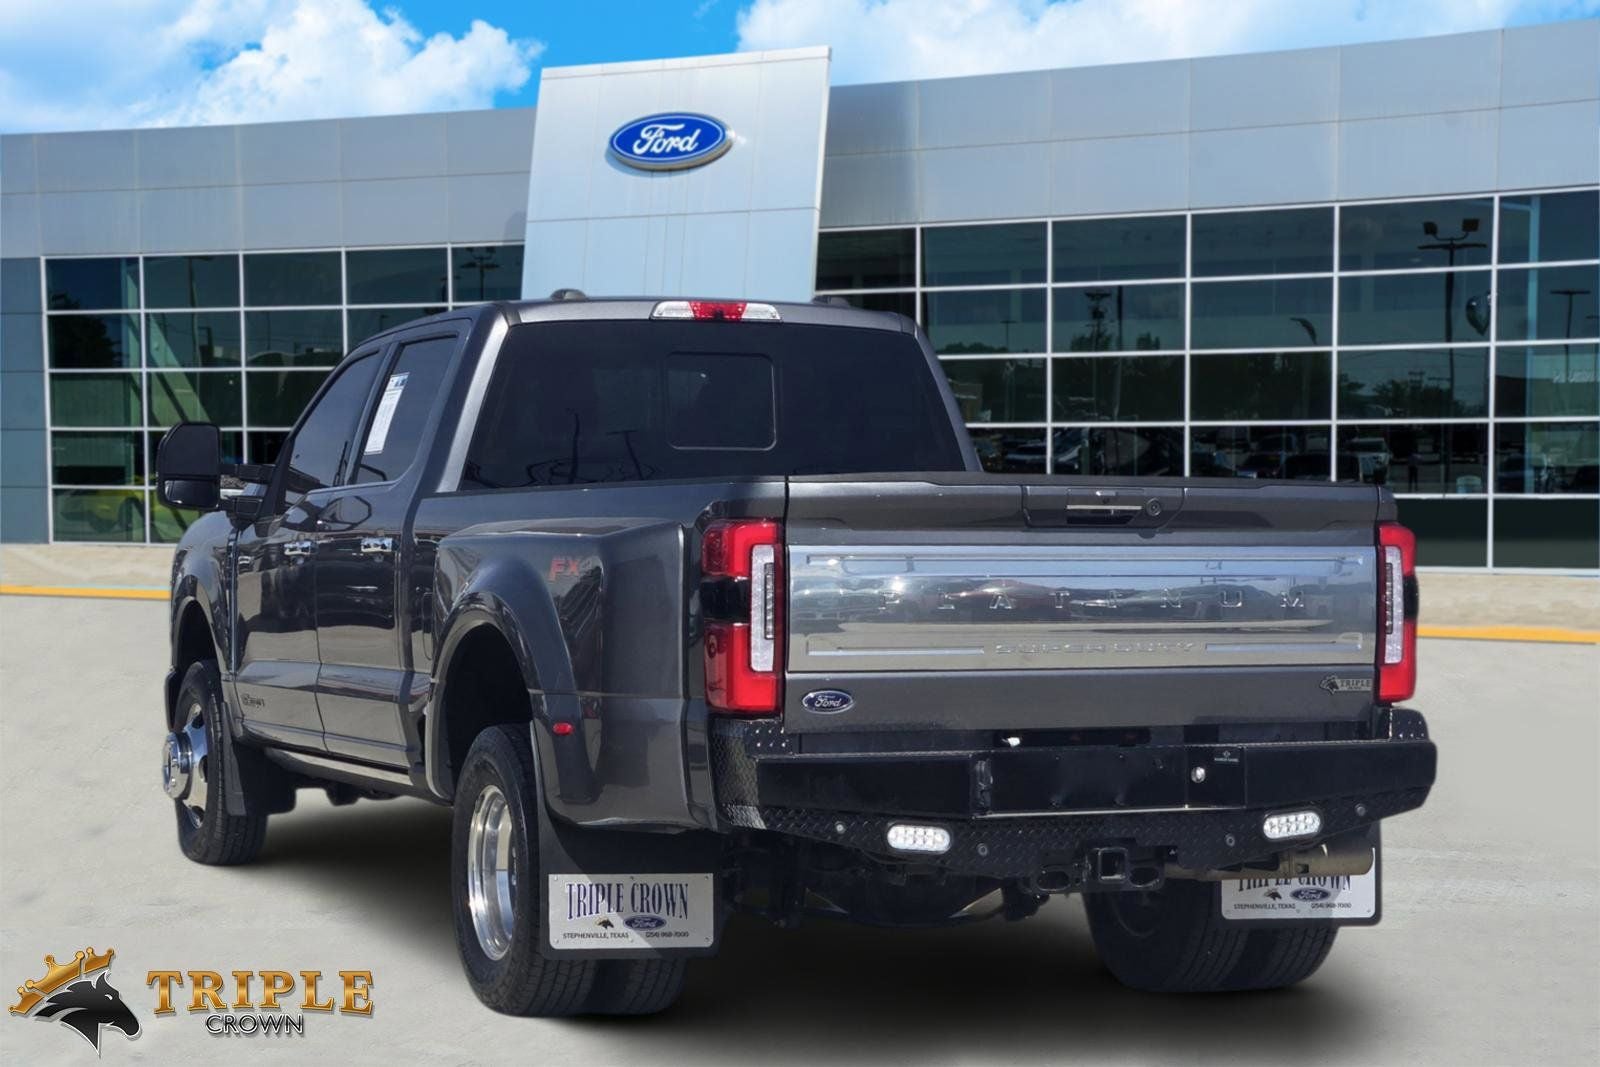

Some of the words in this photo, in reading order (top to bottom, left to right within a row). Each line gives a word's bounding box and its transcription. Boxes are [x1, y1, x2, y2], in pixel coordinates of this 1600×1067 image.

[632, 123, 701, 155] Ford
[878, 590, 1306, 609] PLATINUM
[814, 695, 842, 707] Ford
[567, 883, 624, 919] TRIPLE
[630, 883, 689, 920] CROWN
